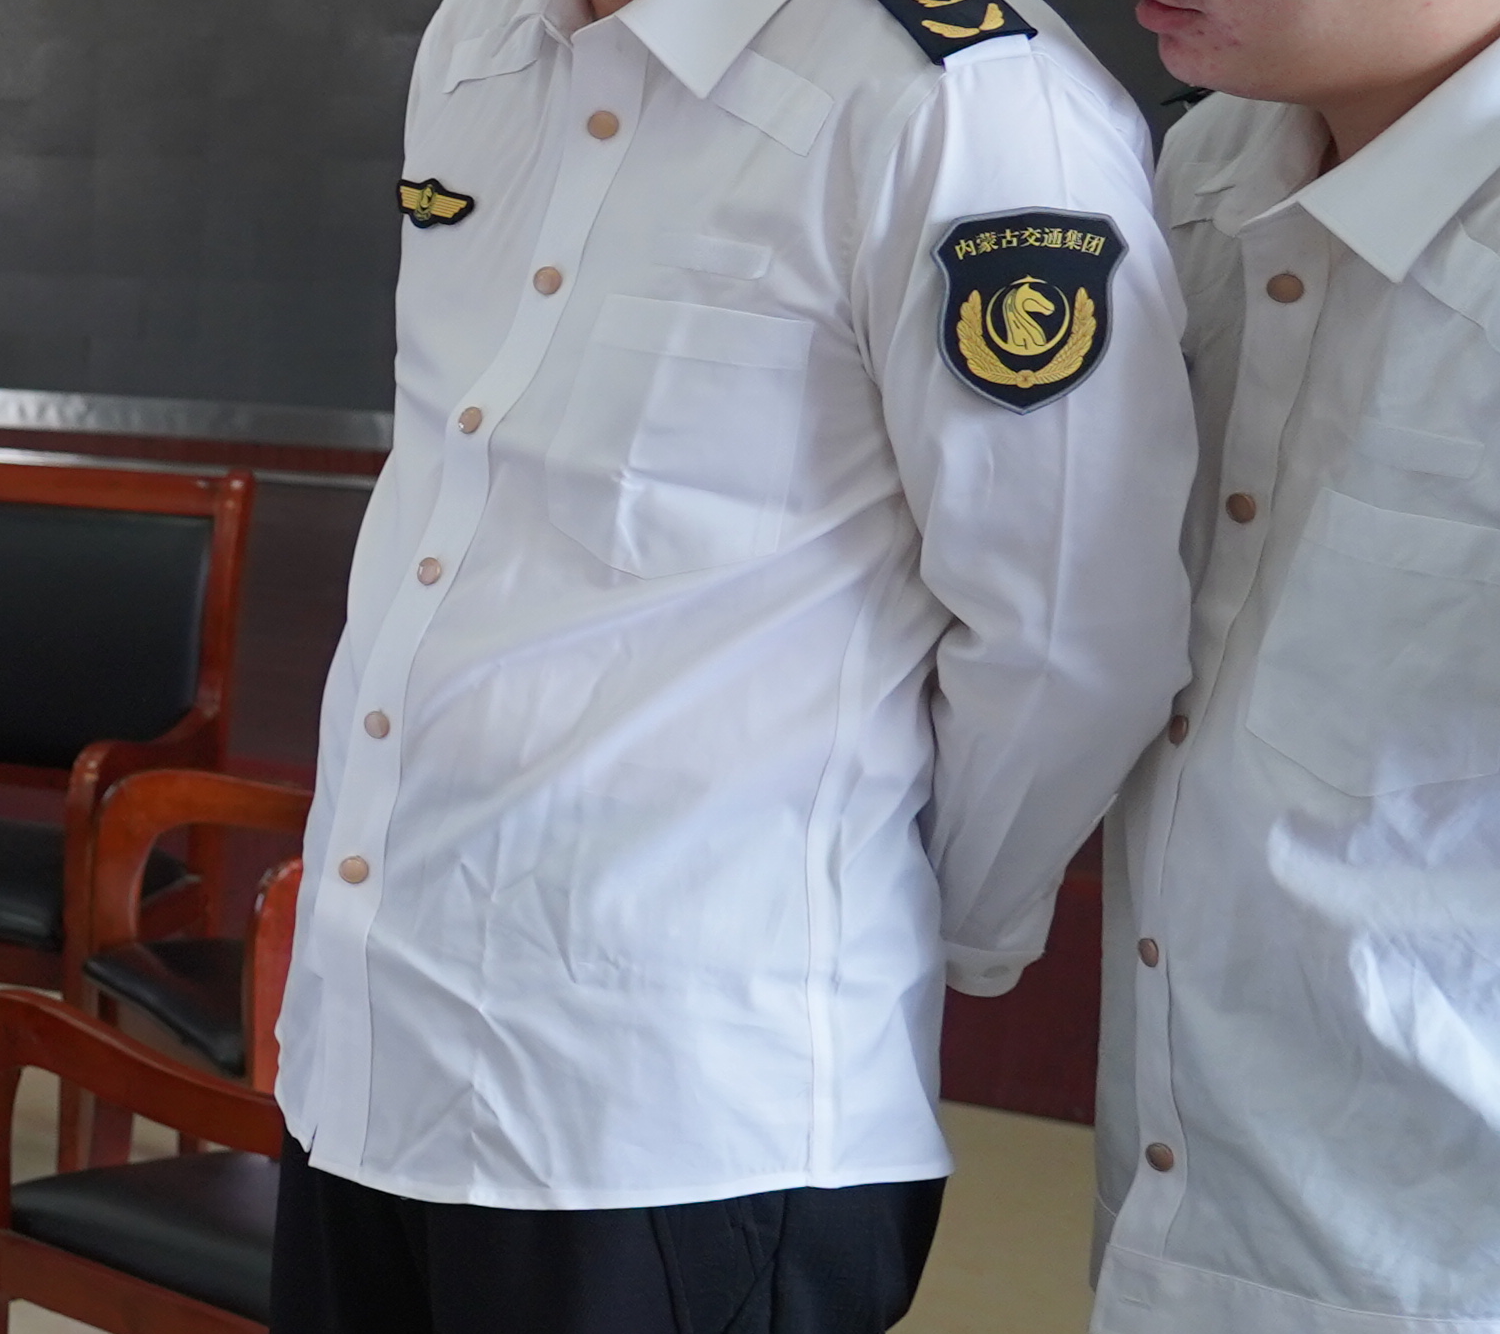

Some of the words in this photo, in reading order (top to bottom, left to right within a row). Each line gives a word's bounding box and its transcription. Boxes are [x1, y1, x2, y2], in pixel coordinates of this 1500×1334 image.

[955, 227, 1106, 260] 内蒙古交通集团
